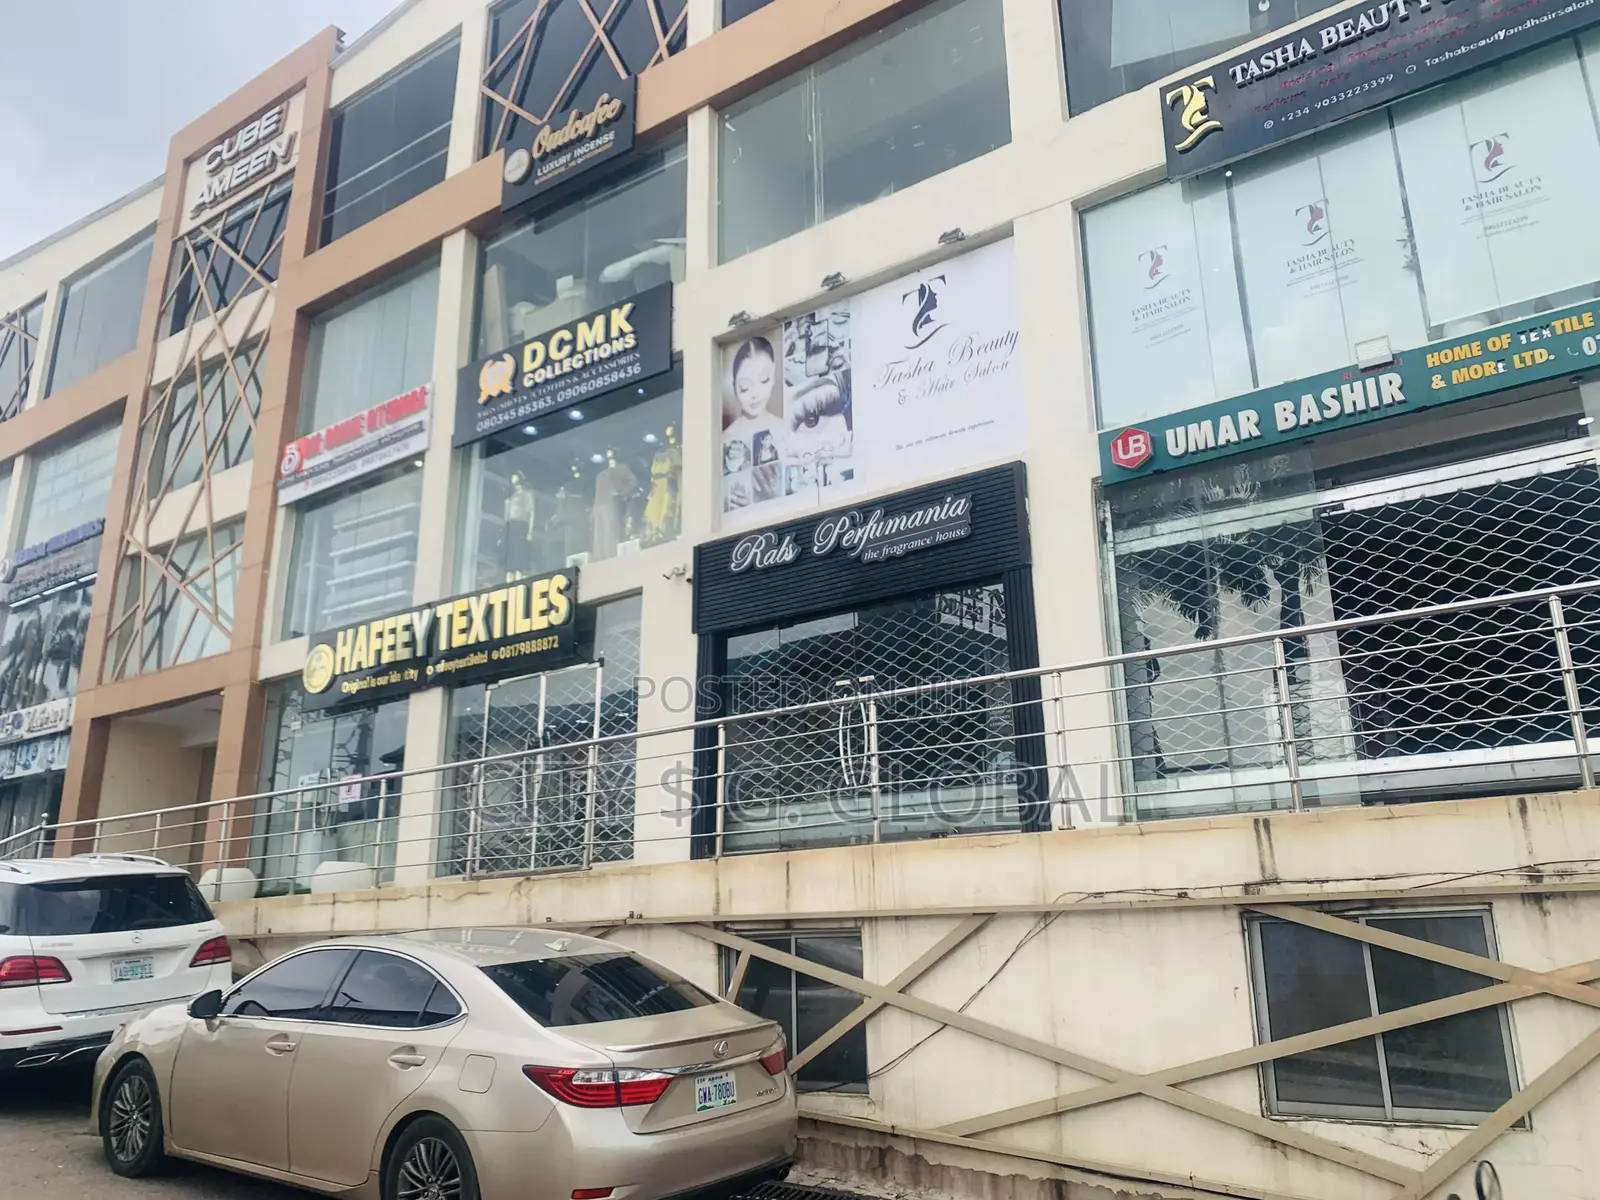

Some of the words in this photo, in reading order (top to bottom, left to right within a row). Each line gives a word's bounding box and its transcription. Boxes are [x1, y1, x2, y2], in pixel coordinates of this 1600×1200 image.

[1229, 37, 1316, 86] TASHA
[1319, 0, 1431, 51] BEAUT
[1280, 107, 1310, 122] +234
[1314, 73, 1395, 110] 9033223399
[206, 105, 282, 174] CUBE
[536, 152, 574, 177] LUXURY
[573, 130, 616, 158] INCENSE
[190, 131, 296, 215] AMEEN
[522, 302, 636, 373] DCMK
[522, 333, 638, 388] COLLECTIONS
[872, 356, 935, 390] Tasha
[948, 330, 1020, 367] Beauty
[1425, 341, 1484, 369] HOME
[1486, 332, 1512, 352] OF
[1516, 311, 1595, 345] TEXTILE
[915, 374, 956, 399] Hair
[963, 358, 1010, 383] Salon
[1431, 374, 1448, 390] &
[1451, 359, 1508, 385] MORE
[1512, 348, 1556, 370] LTD.
[1165, 409, 1262, 458] UMAR
[1273, 372, 1407, 433] BASHIR
[812, 494, 970, 557] Perfumania
[864, 548, 880, 562] the
[879, 536, 934, 561] fragrance
[935, 525, 969, 543] house
[333, 607, 434, 676] HAFEEY
[435, 573, 571, 651] TEXTILES
